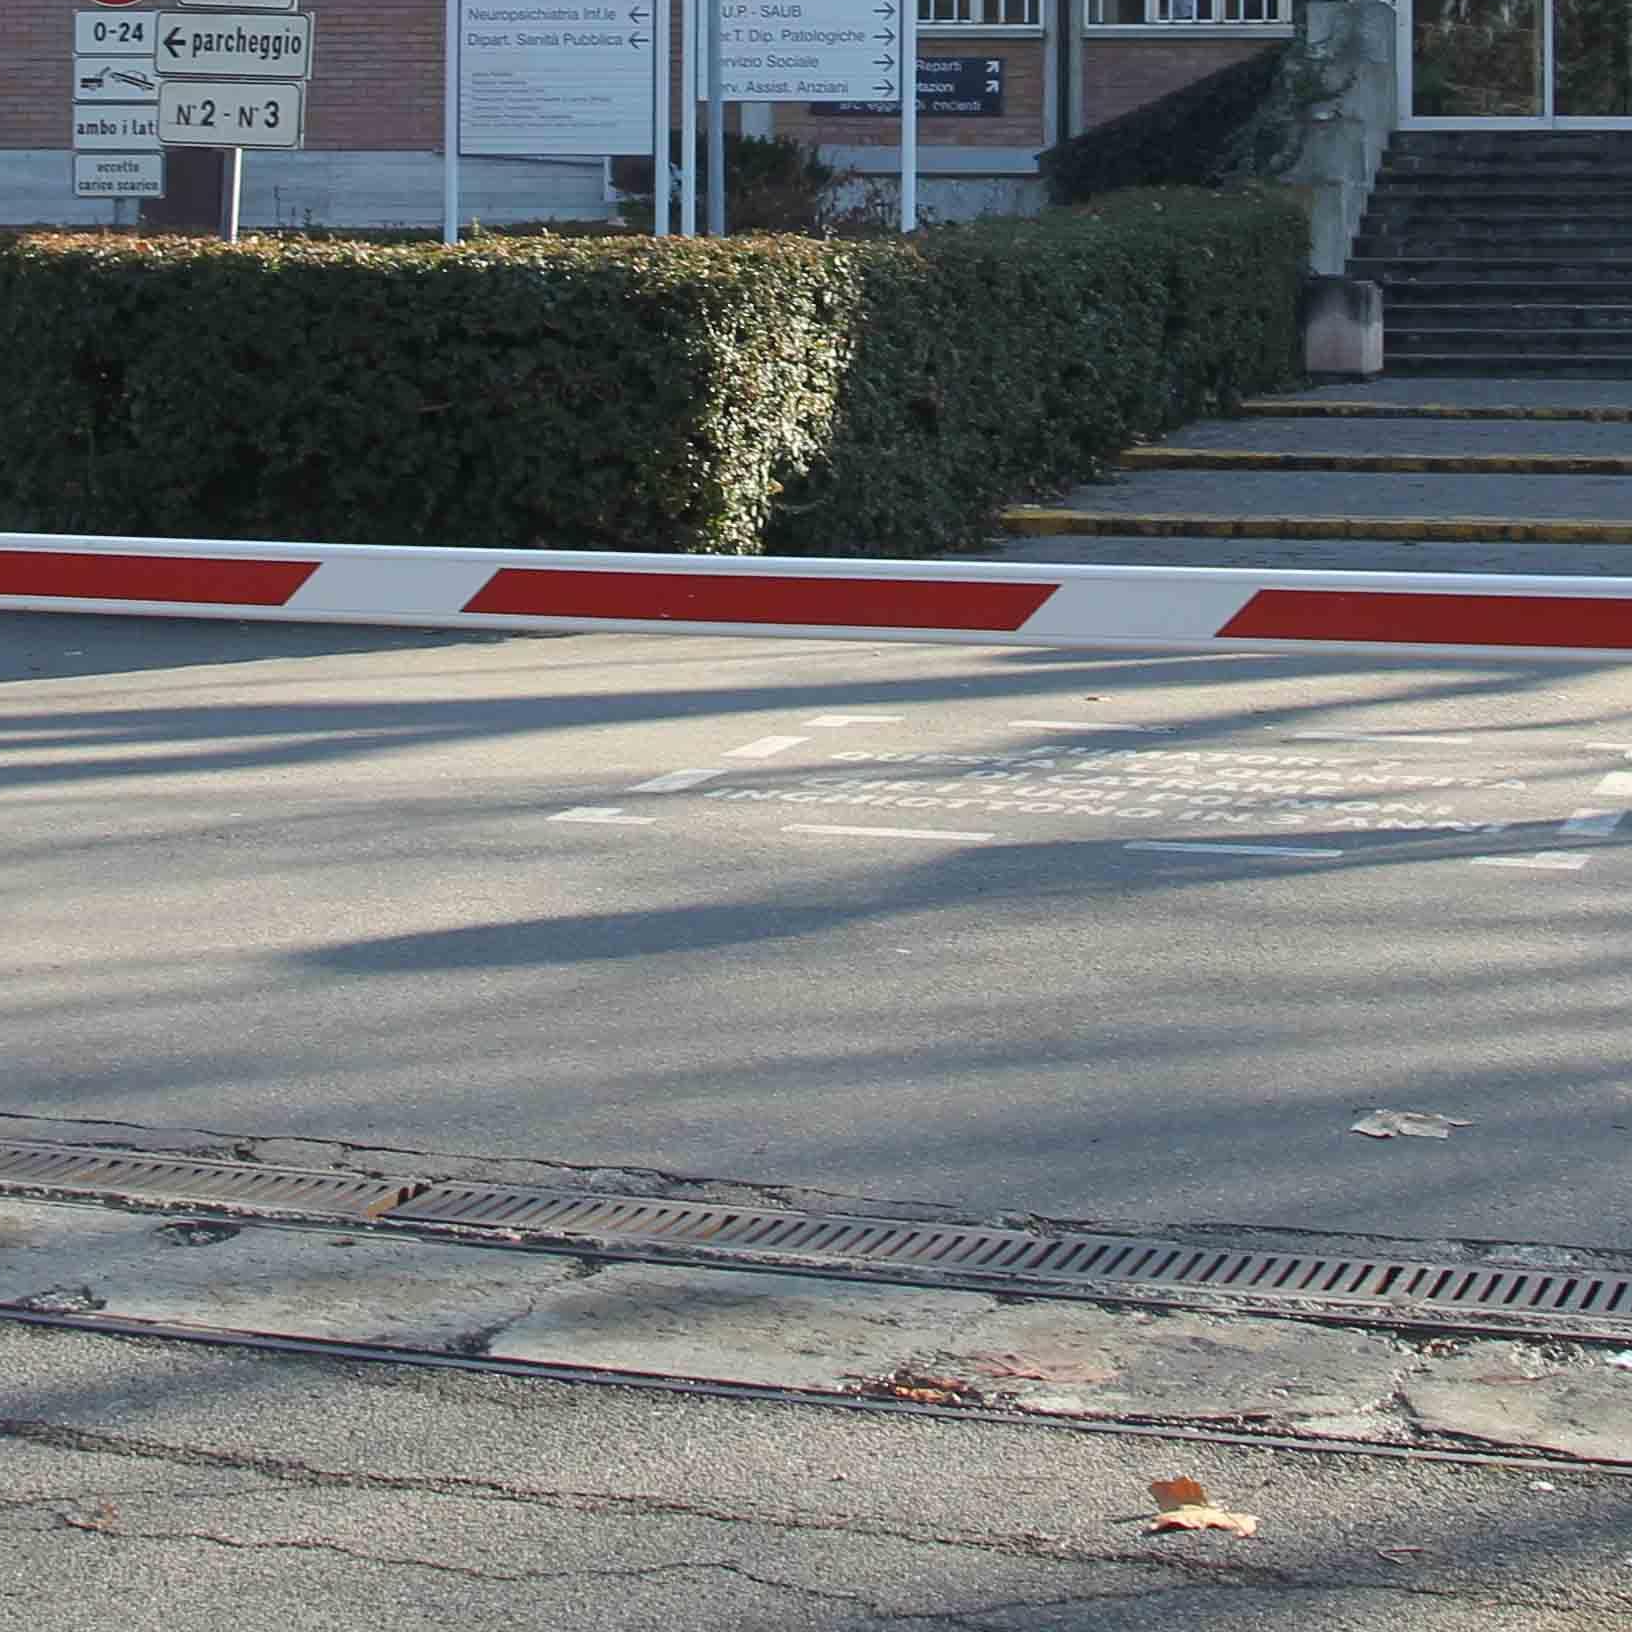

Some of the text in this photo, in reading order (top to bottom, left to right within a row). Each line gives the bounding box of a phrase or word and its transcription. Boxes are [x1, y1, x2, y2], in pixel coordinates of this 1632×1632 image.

[760, 4, 802, 18] SAUB
[93, 21, 144, 43] 0-24
[563, 32, 624, 46] Pubblica
[780, 28, 865, 45] Patologiche
[191, 26, 302, 60] parcheggio
[766, 54, 819, 68] Sociale
[797, 79, 849, 94] Anziani
[77, 119, 117, 136] ambo
